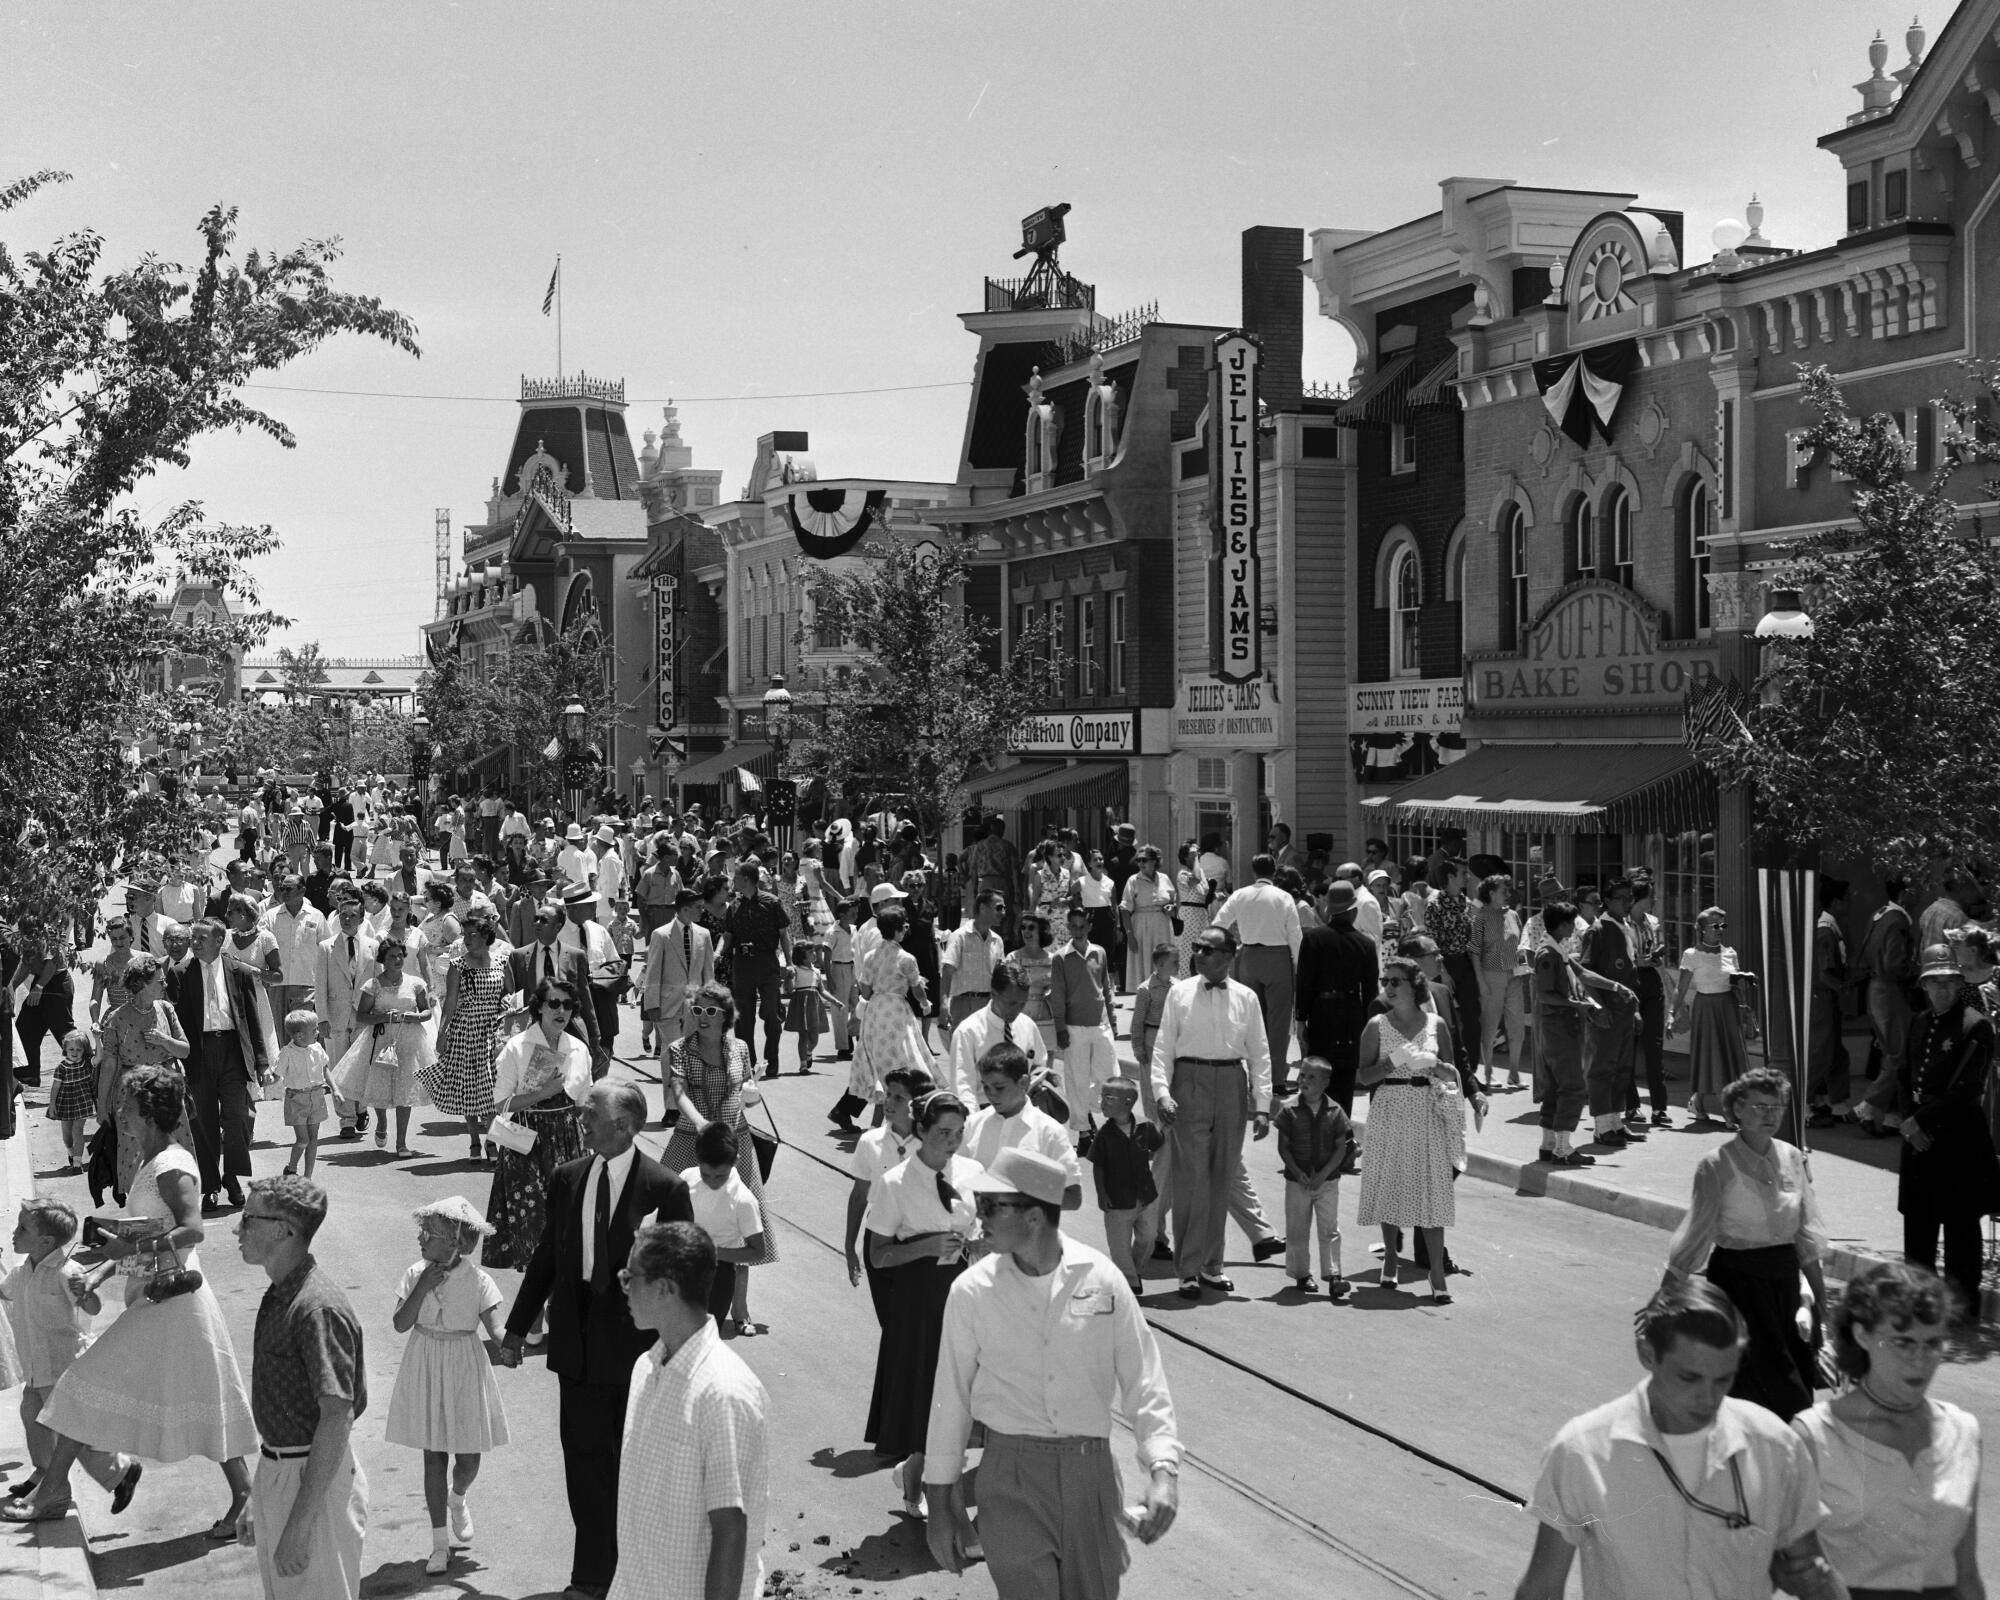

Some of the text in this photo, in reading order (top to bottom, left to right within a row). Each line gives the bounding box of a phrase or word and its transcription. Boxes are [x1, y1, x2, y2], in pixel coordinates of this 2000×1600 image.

[1229, 348, 1250, 660] JELLIES & JAMS
[657, 576, 675, 587] THE
[1533, 591, 1655, 661] PUFFIN
[661, 591, 673, 721] UPJOHN CO
[1188, 685, 1225, 712] JELLIES
[1234, 683, 1260, 711] JAMS
[1484, 666, 1580, 699] BAKE
[1357, 690, 1395, 711] SUNNY
[1400, 688, 1430, 709] VIEW
[1070, 715, 1130, 749] Company
[1178, 718, 1216, 735] PRESERVES
[1227, 717, 1273, 735] DISTINCTION
[1384, 714, 1423, 727] JELLIES
[1432, 713, 1440, 725] &
